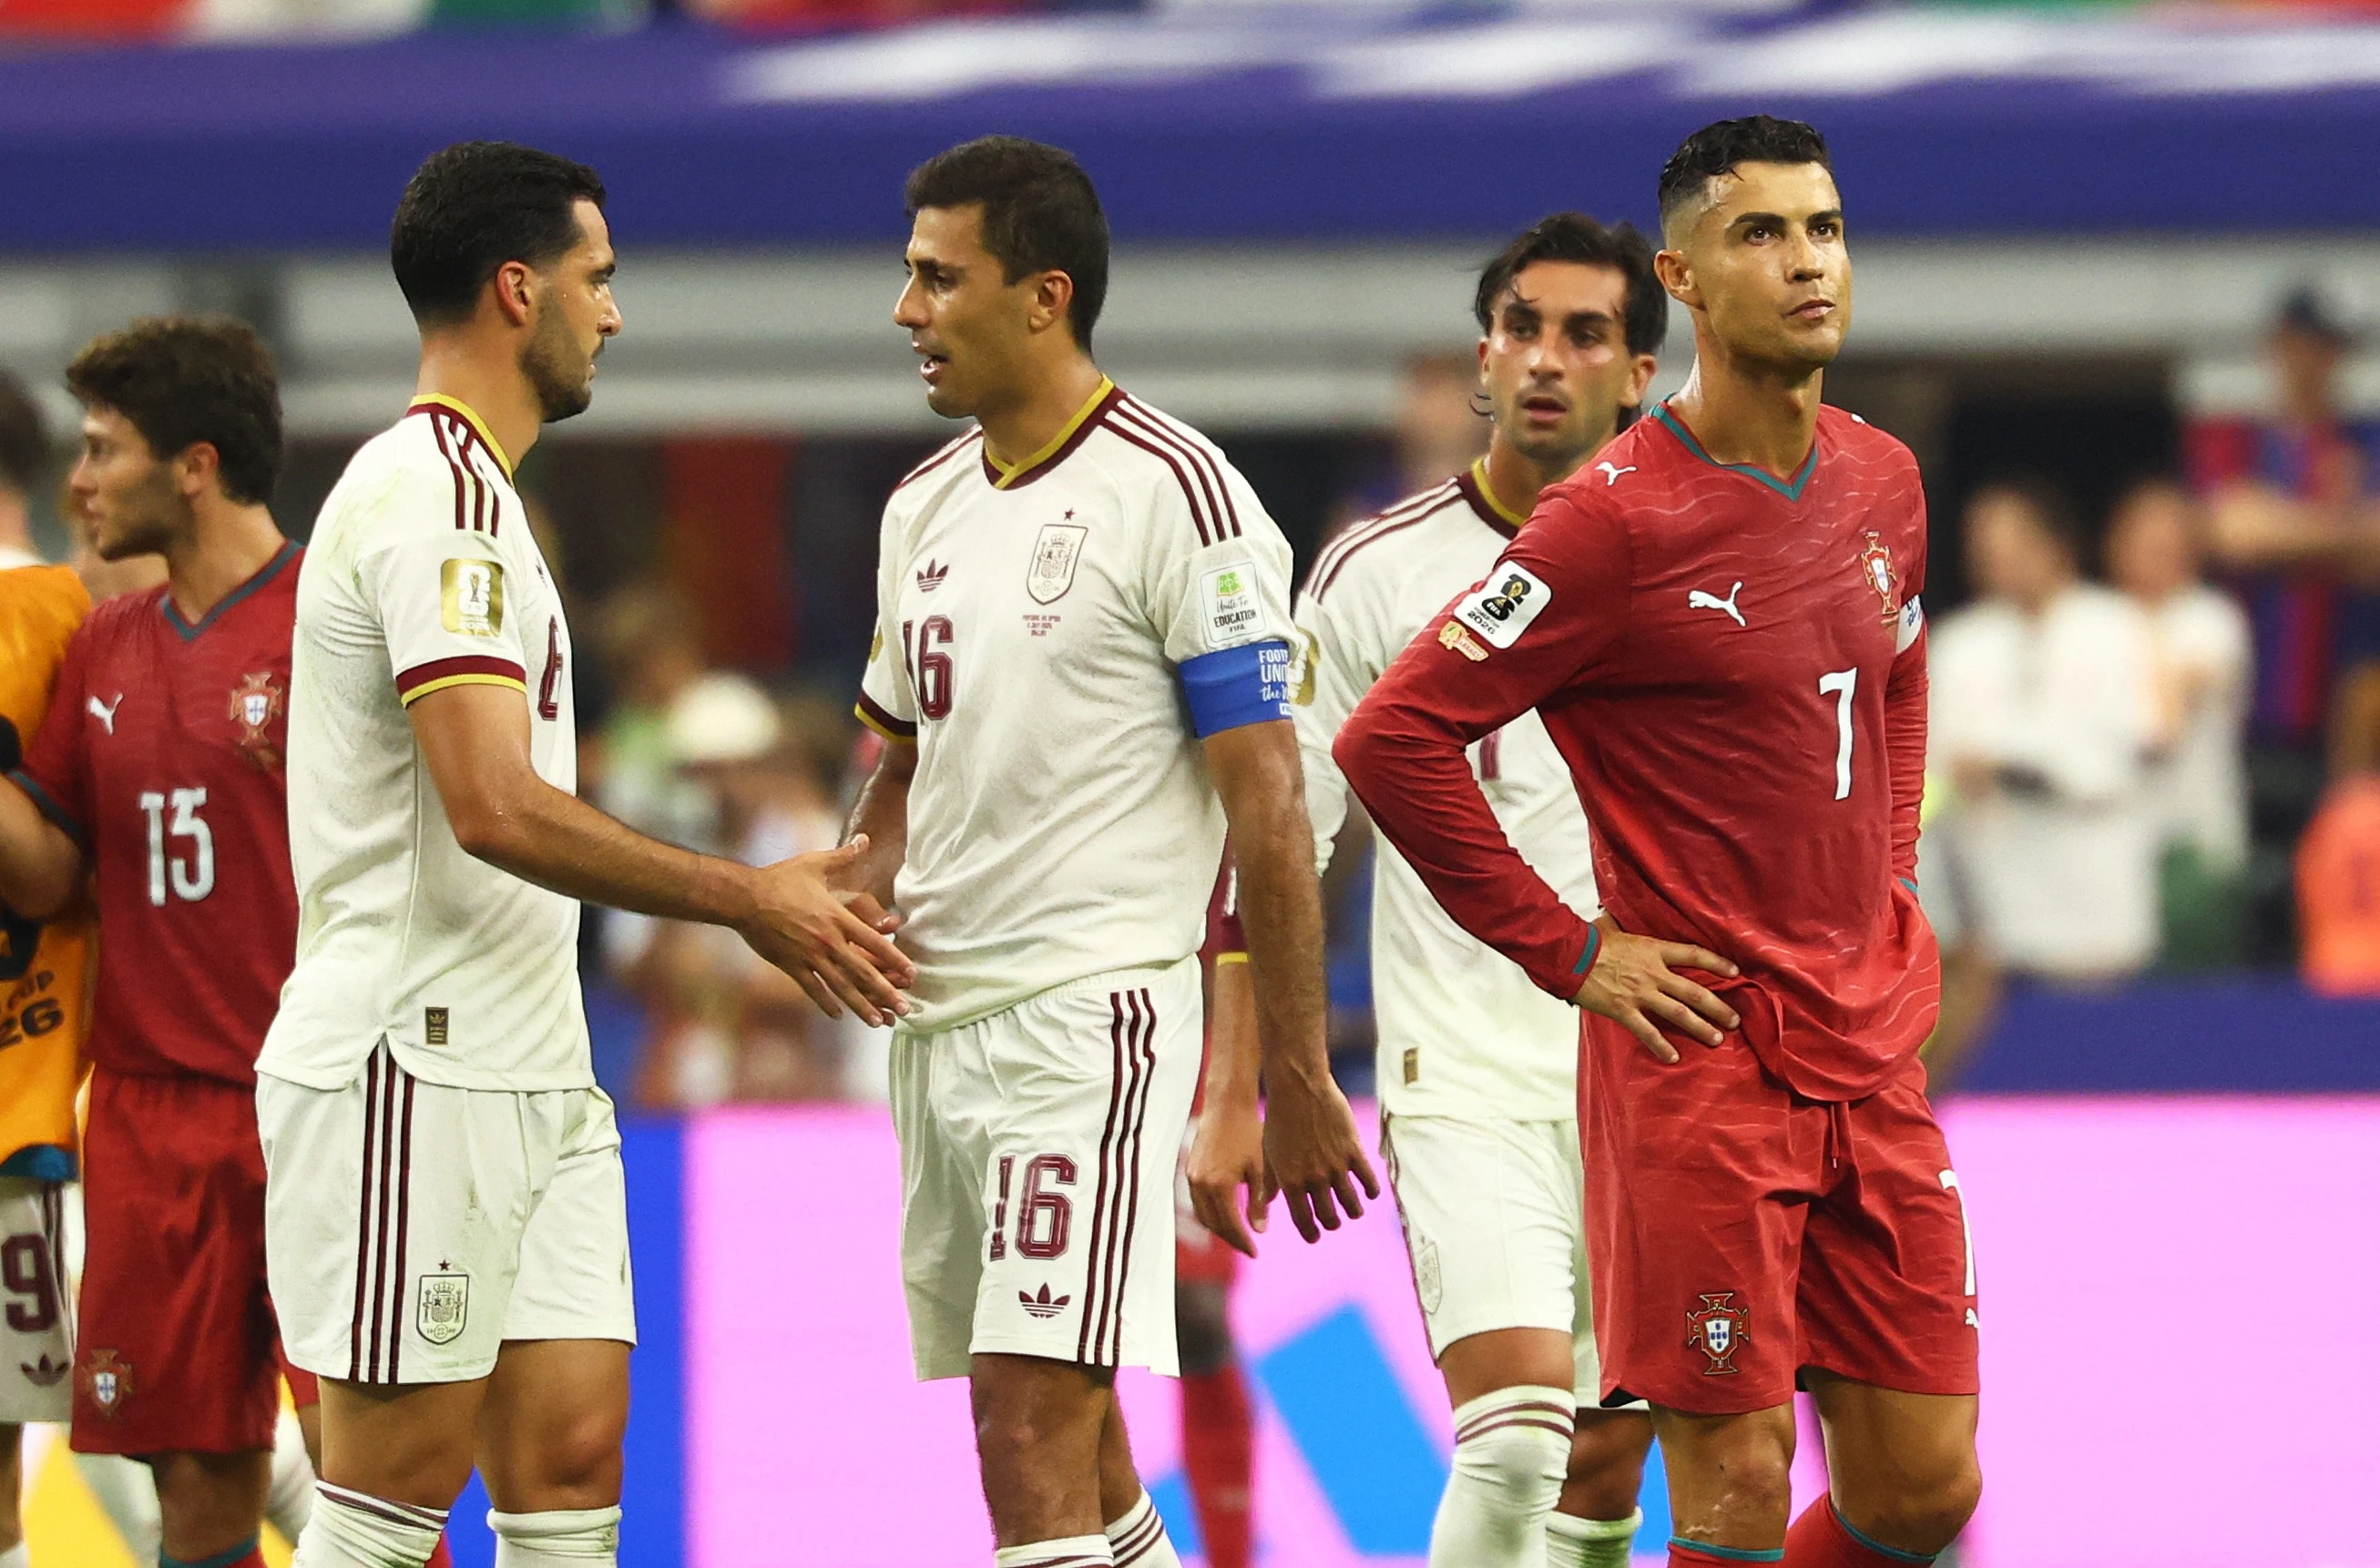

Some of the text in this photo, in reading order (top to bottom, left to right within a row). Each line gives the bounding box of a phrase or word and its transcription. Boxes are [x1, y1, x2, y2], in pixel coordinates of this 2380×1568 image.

[1213, 608, 1258, 628] EDUCATION
[1467, 610, 1496, 635] 2026
[1486, 601, 1501, 616] FIFA
[903, 614, 954, 726] 16
[1260, 684, 1281, 702] the
[1818, 667, 1857, 801] 7
[139, 787, 216, 907] 13
[989, 1153, 1078, 1262] 16
